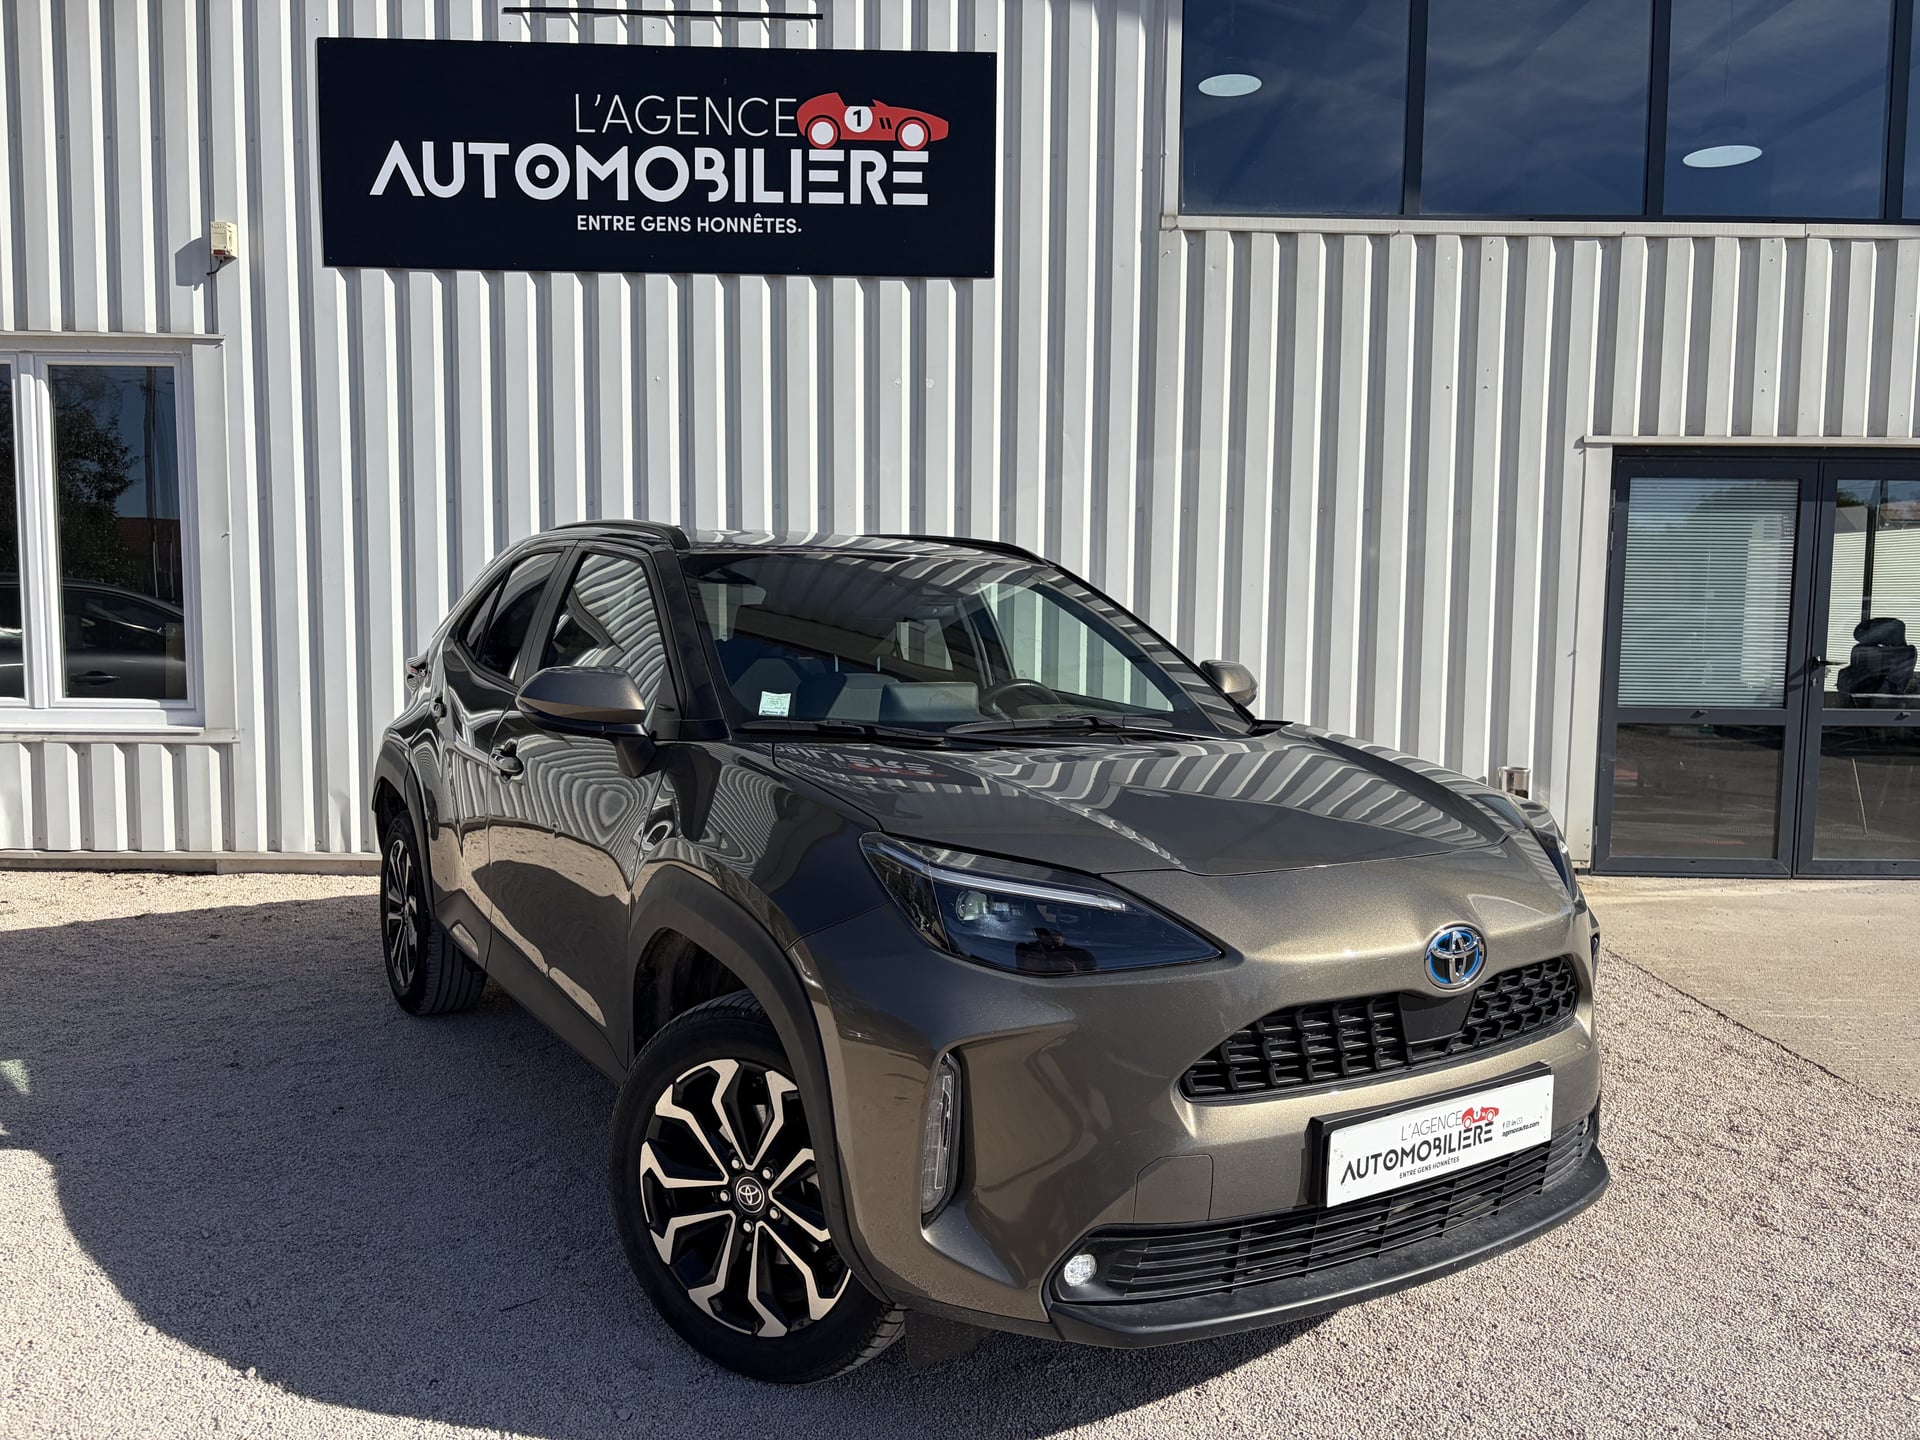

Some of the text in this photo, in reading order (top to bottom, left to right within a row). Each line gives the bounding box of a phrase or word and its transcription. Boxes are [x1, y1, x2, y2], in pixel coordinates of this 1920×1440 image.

[575, 94, 797, 136] L'AGENCE
[853, 109, 862, 127] 1
[369, 140, 929, 206] AUTOMOBILIERE
[577, 213, 802, 233] ENTRE GENS HONNÊTES.
[1401, 1110, 1462, 1141] L'AGENCE
[1341, 1121, 1493, 1185] AUTOMOBILIERE
[1399, 1168, 1417, 1179] ENTRE
[1417, 1163, 1432, 1174] GENS
